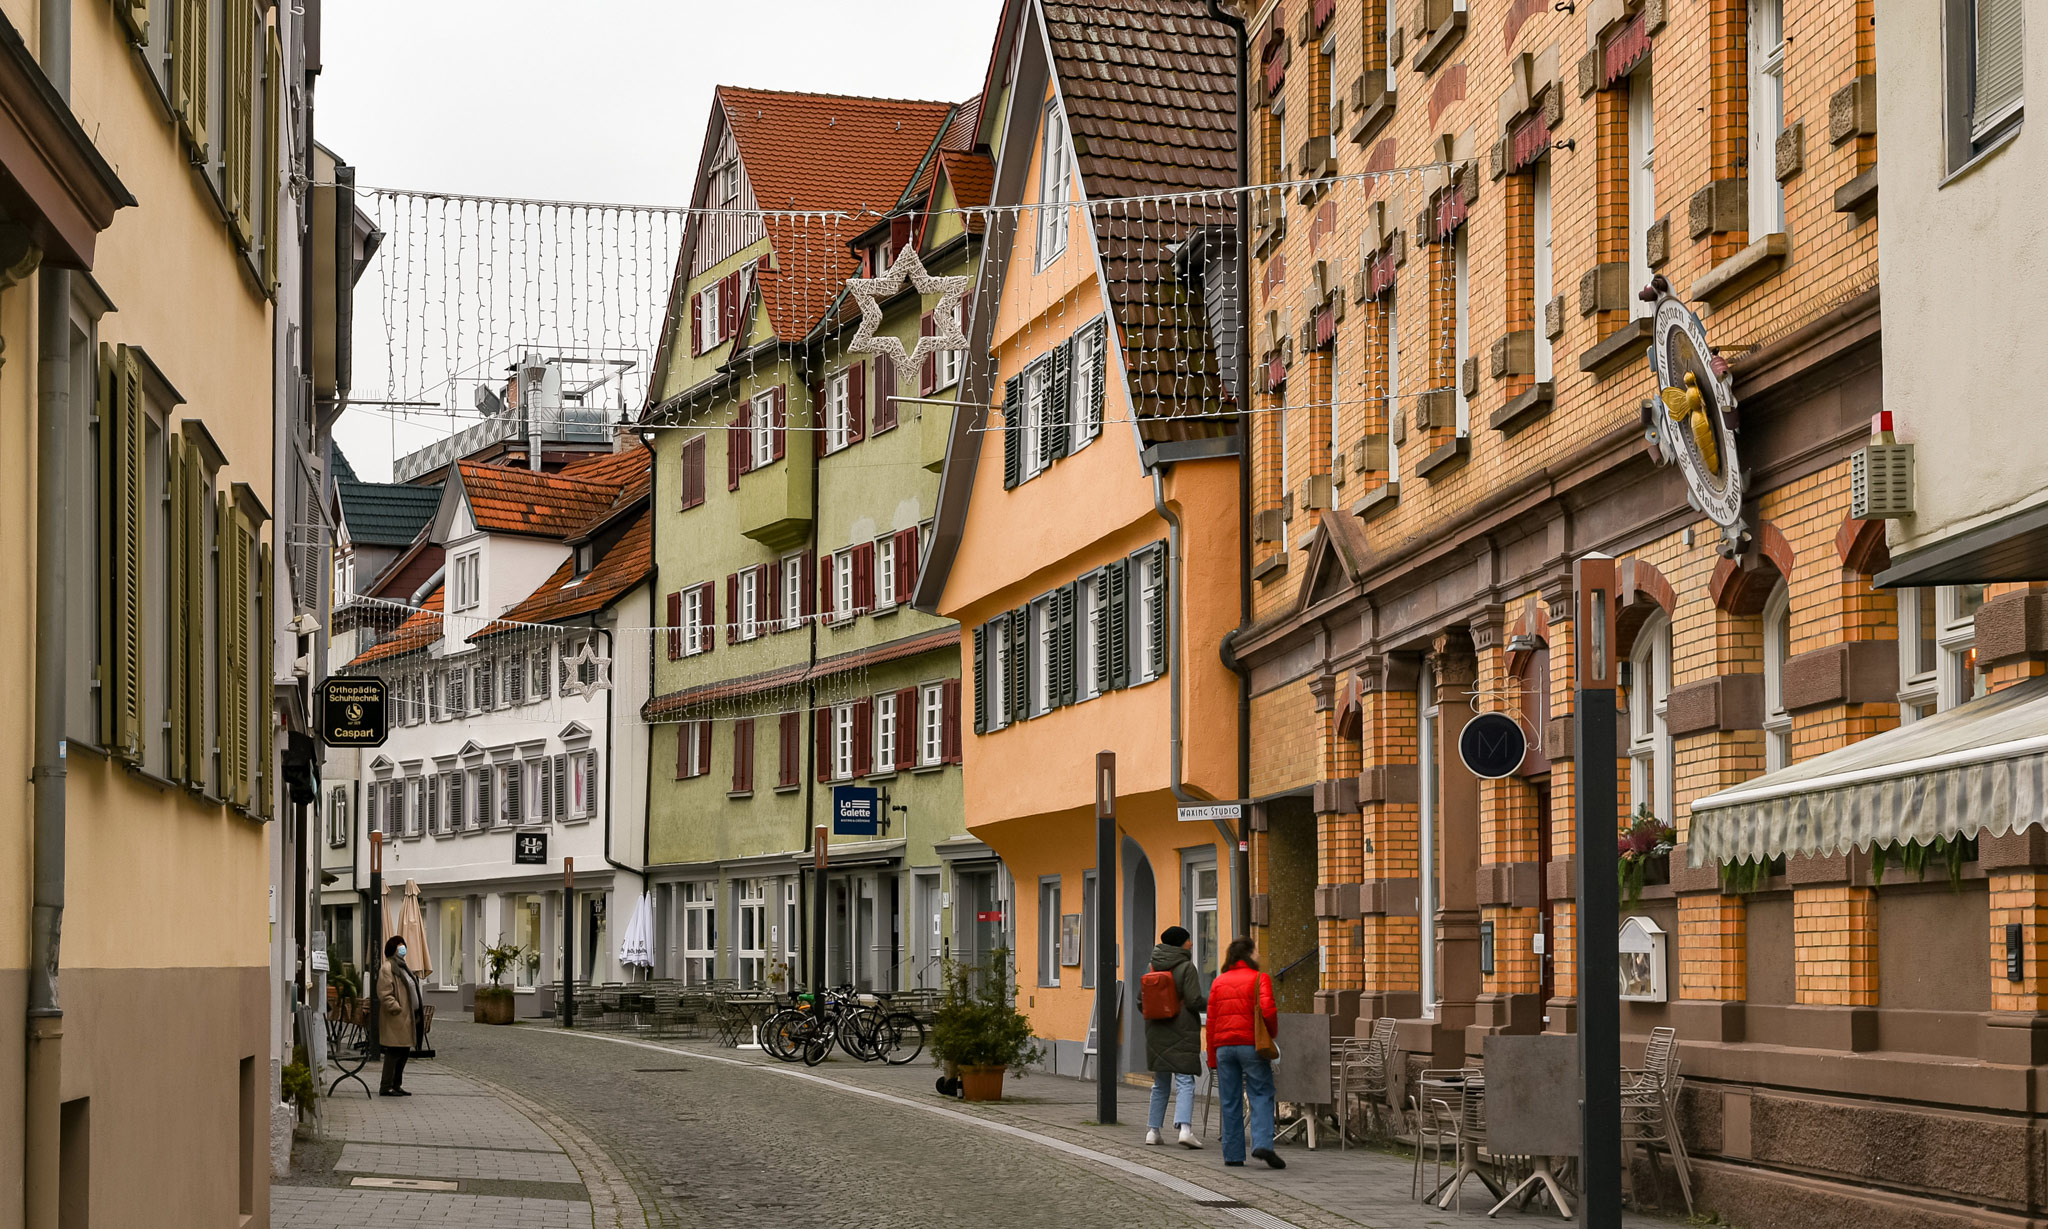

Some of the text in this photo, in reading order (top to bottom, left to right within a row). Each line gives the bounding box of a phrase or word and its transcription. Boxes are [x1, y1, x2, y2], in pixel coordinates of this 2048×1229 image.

[1656, 306, 1685, 346] Goldenen
[1659, 350, 1668, 387] Zur
[1695, 477, 1728, 520] Robert
[329, 686, 380, 695] Orthopädie-
[334, 727, 374, 739] Caspart
[840, 800, 851, 808] La
[840, 808, 871, 817] Galette
[1210, 806, 1240, 816] STUDIO
[524, 837, 537, 854] H
